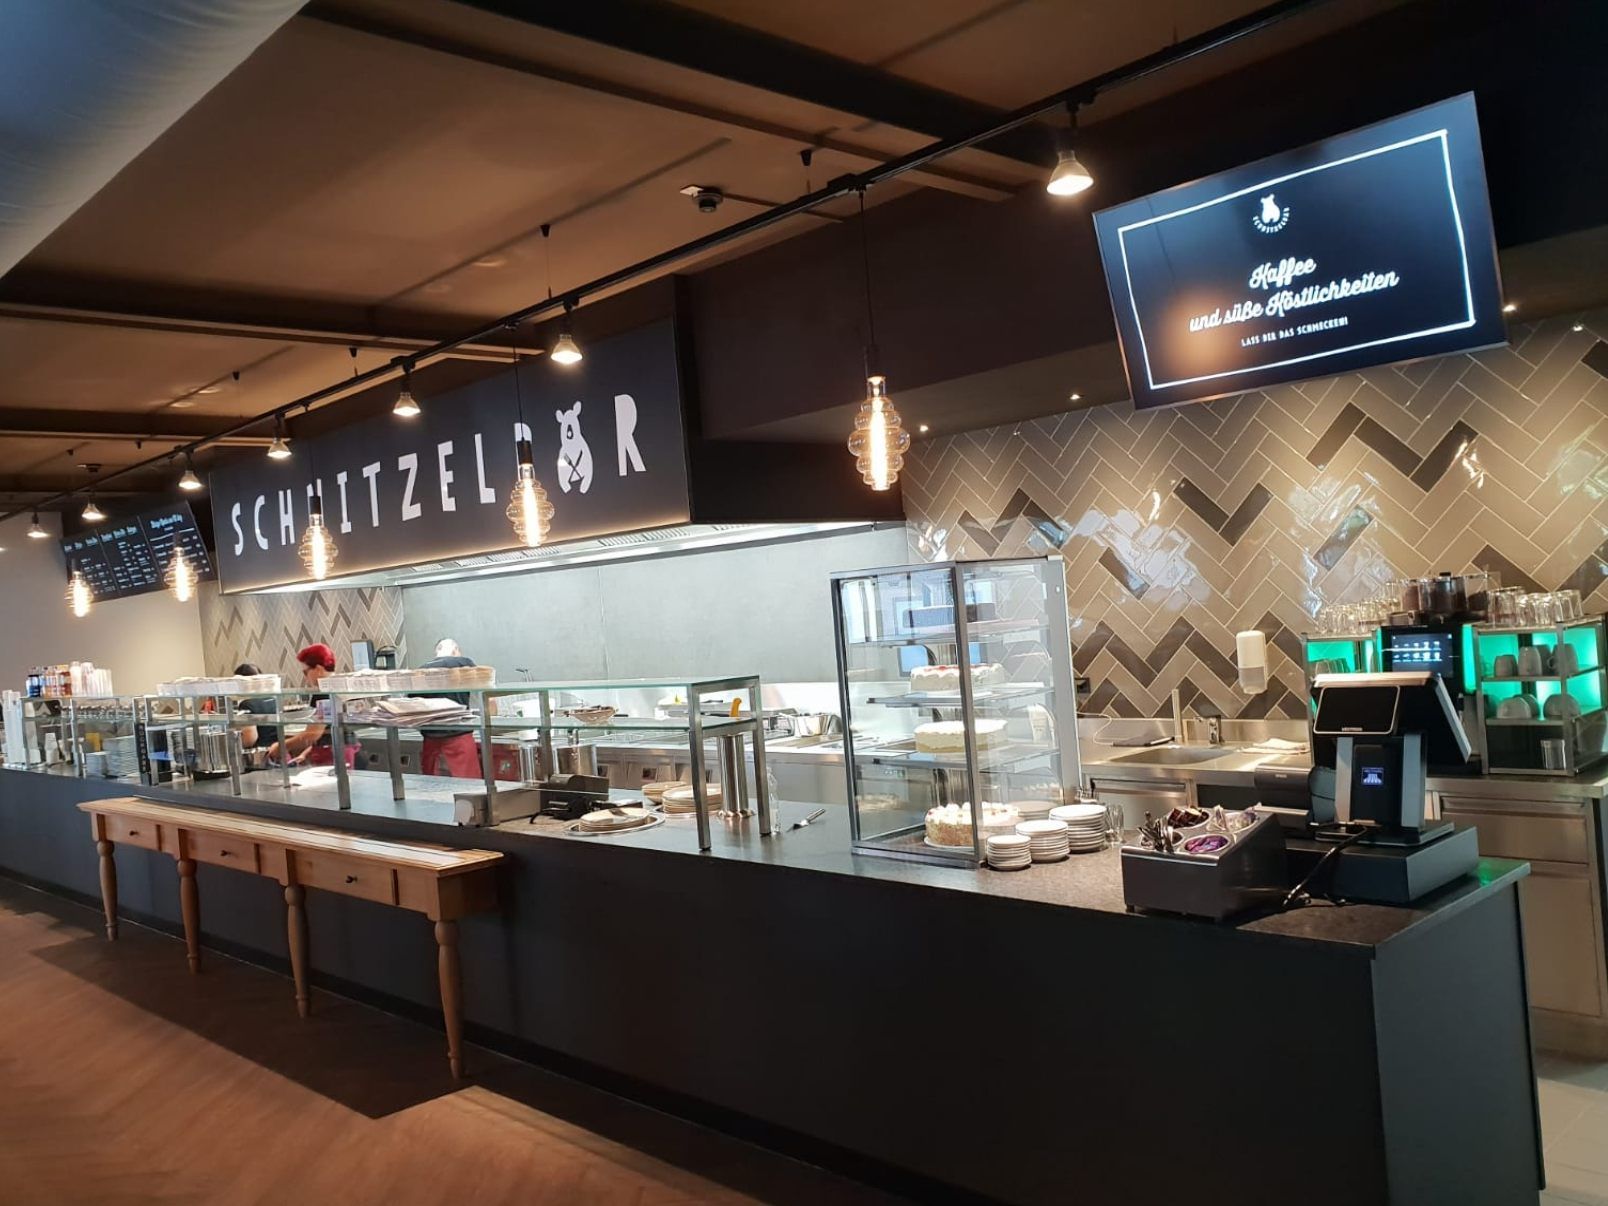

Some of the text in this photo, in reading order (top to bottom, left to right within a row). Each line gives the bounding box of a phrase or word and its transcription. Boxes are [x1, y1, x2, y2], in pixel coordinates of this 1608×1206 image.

[1249, 257, 1317, 289] Kaffee
[1189, 271, 1399, 332] und süße Köstlichkeiten
[1241, 335, 1260, 347] LASS
[1279, 327, 1295, 339] DAS
